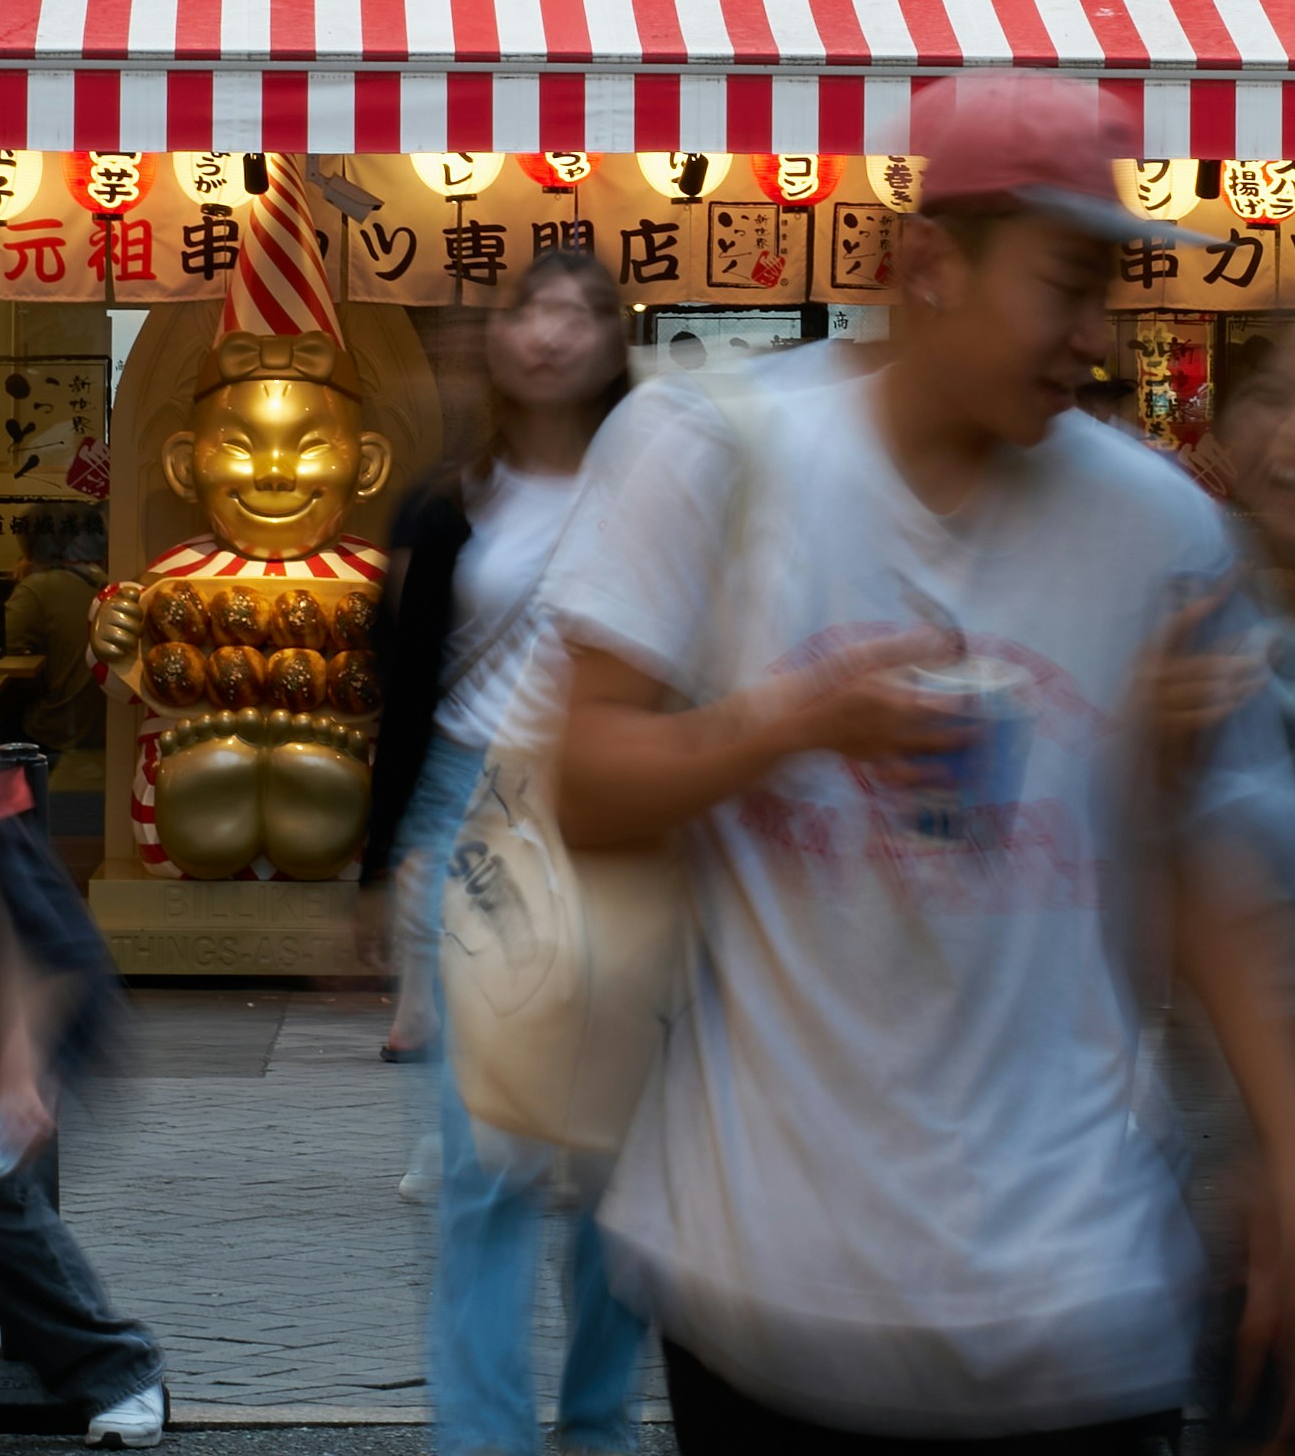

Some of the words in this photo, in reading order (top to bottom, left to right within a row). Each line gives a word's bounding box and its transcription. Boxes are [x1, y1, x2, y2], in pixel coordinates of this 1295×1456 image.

[93, 152, 133, 203] 芋
[884, 155, 913, 206] 巻き
[1228, 161, 1265, 214] 揚げ
